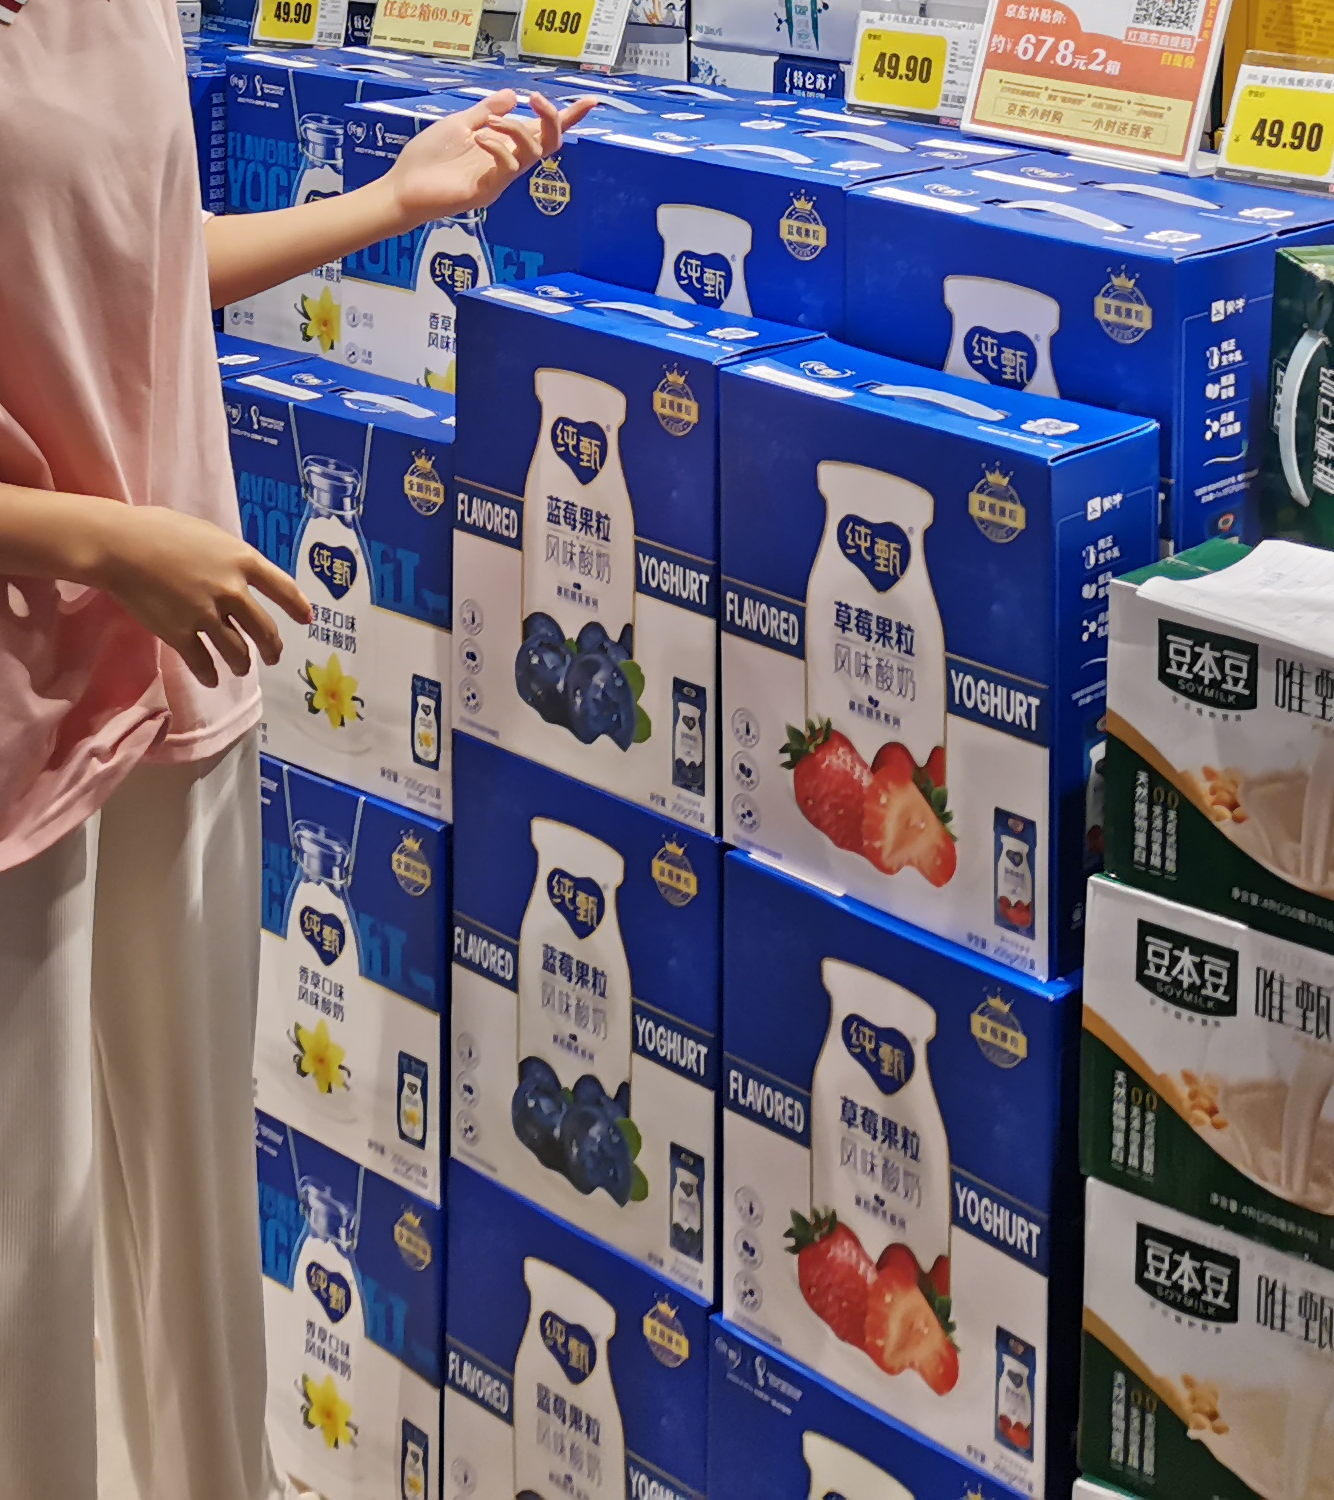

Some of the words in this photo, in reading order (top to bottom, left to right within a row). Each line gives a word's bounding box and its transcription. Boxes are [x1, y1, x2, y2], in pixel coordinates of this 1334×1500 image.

[274, 1, 312, 25] 49.90
[535, 9, 581, 34] 49.90
[793, 70, 834, 91] 特仑苏
[873, 51, 932, 84] 49.90
[1005, 103, 1064, 124] 京东小时购
[1082, 117, 1154, 140] 一小时送到家
[1250, 118, 1323, 153] 49.90
[435, 258, 473, 290] 纯甄
[679, 257, 728, 301] 纯甄
[972, 333, 1028, 382] 纯甄
[557, 422, 602, 472] 纯甄
[456, 492, 519, 539] FLAVORED
[546, 495, 612, 543] 蓝莓果粒
[313, 546, 353, 587] 纯甄
[544, 533, 612, 585] 风味酸奶
[845, 522, 903, 579] 纯甄
[638, 551, 710, 606] YOGHURT
[308, 625, 357, 654] 风味酸奶
[725, 591, 800, 647] FLAVORED
[833, 600, 916, 658] 草莓果粒
[832, 643, 916, 704] 风味酸奶
[1166, 635, 1251, 696] 豆本豆
[1177, 678, 1237, 705] SOYMILK
[951, 668, 1040, 732] YOGHURT
[552, 873, 598, 928] 纯甄
[304, 913, 341, 957] 纯甄
[454, 925, 514, 981] FLAVORED
[542, 942, 608, 1000] 蓝莓果粒
[1143, 935, 1231, 1003] 豆本豆
[635, 1013, 708, 1077] YOGHURT
[850, 1019, 908, 1083] 纯甄
[729, 1068, 805, 1134] FLAVORED
[840, 1096, 921, 1166] 草莓果粒
[840, 1135, 922, 1209] 风味酸奶
[955, 1181, 1041, 1259] YOGHURT
[311, 1268, 348, 1315] 纯甄
[1144, 1238, 1233, 1311] 豆本豆
[448, 1350, 510, 1413] FLAVORED
